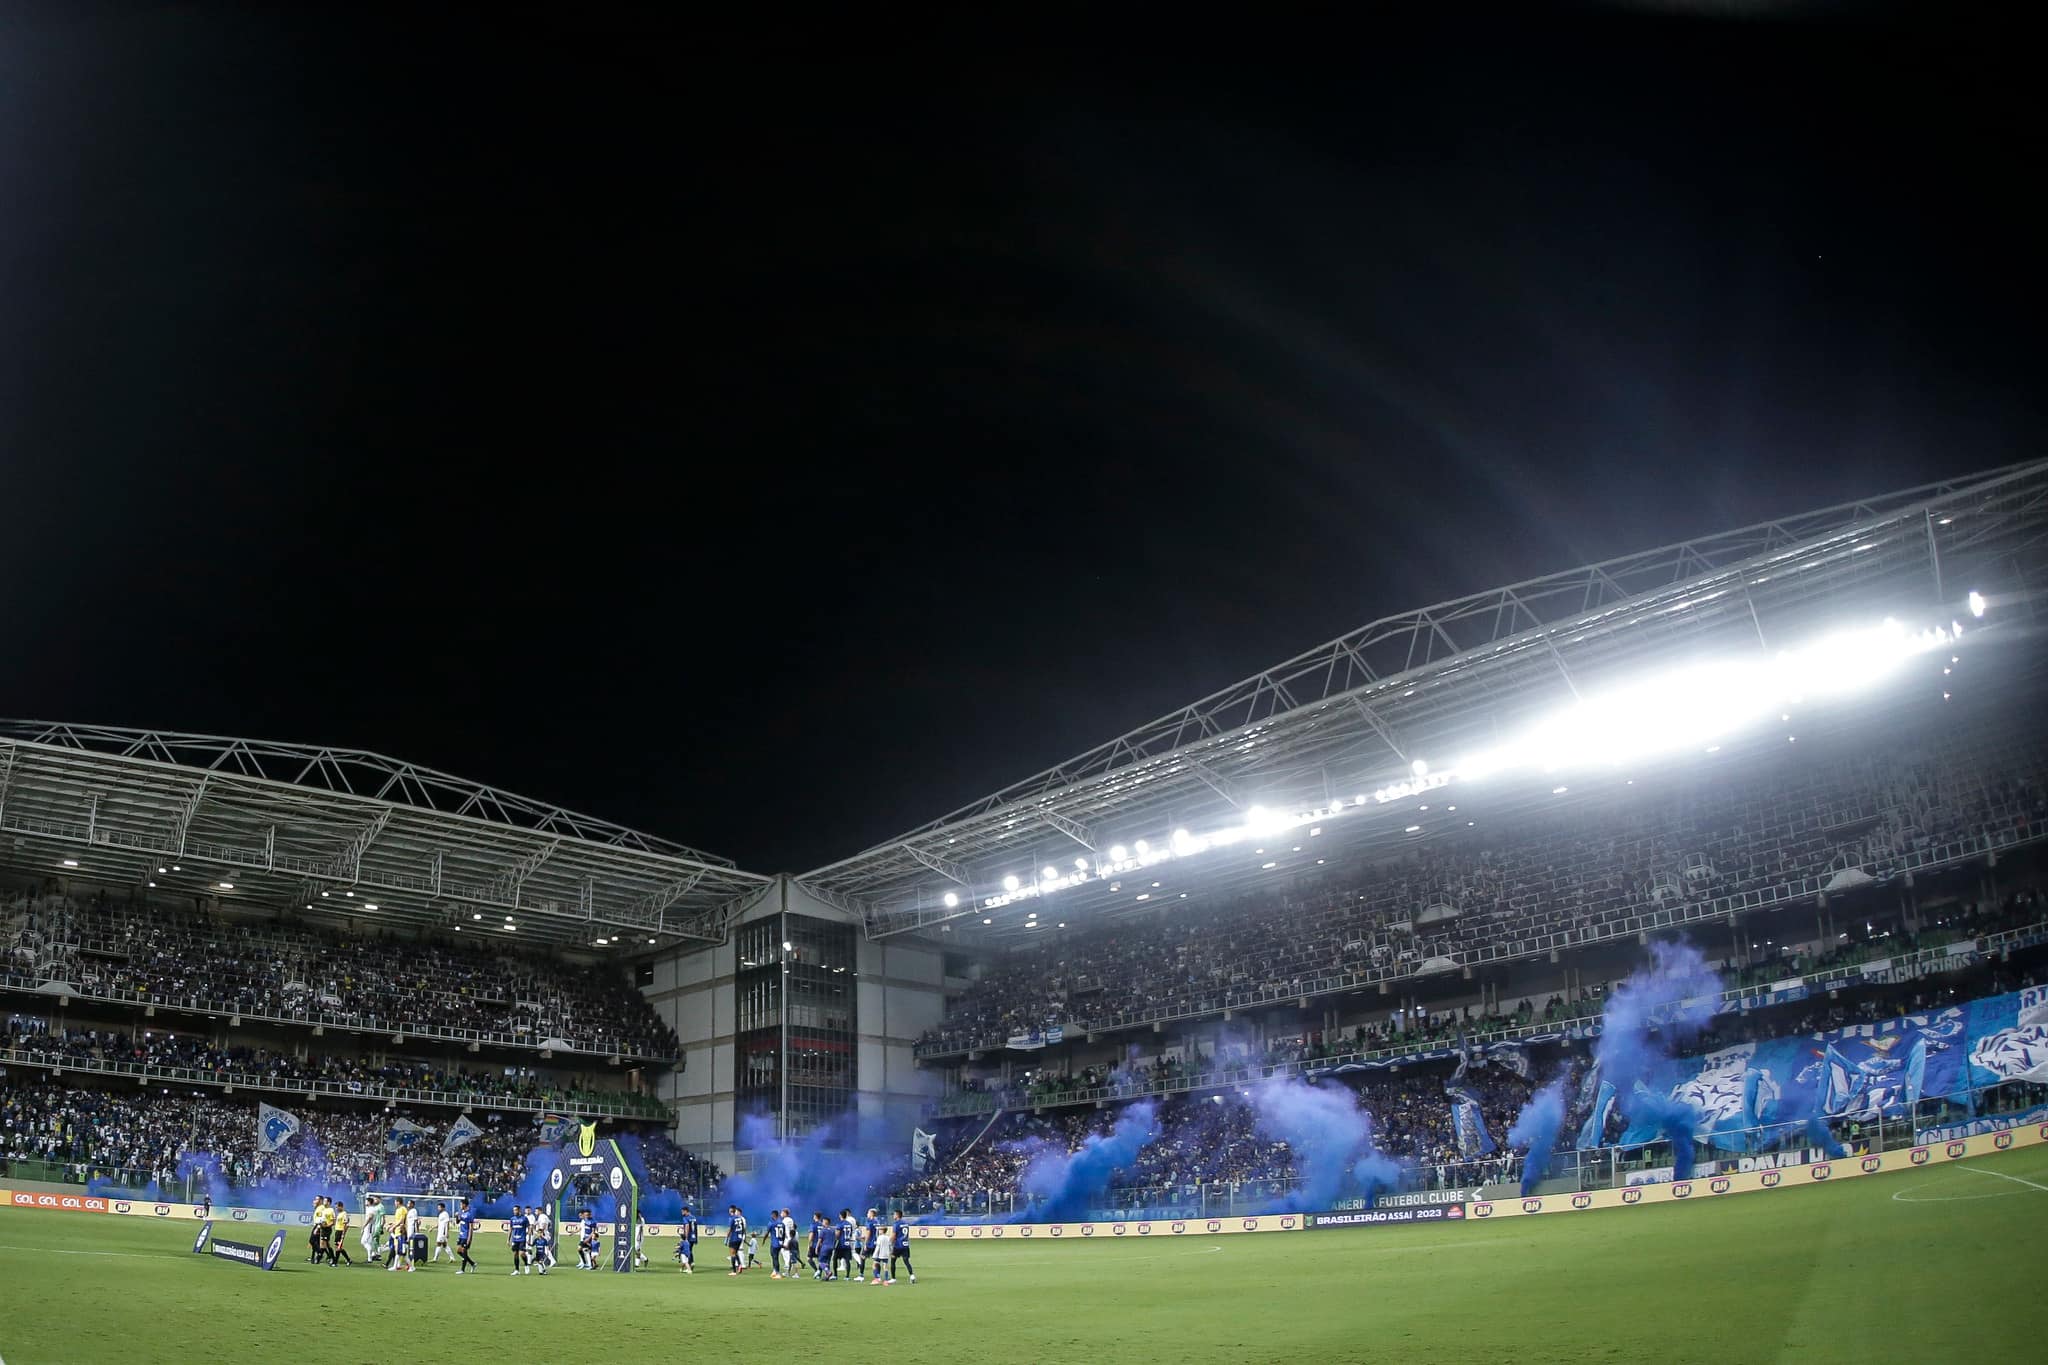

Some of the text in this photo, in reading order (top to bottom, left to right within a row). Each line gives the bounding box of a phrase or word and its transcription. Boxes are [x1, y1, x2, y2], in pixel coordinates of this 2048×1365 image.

[1996, 1135, 2011, 1147] BH
[1949, 1143, 1964, 1156] BH
[1912, 1151, 1928, 1162] BH
[1864, 1159, 1878, 1170] BH
[1814, 1167, 1829, 1178] BH
[1763, 1174, 1778, 1185] BH
[1675, 1185, 1690, 1195] BH
[1713, 1181, 1728, 1192] BH
[1378, 1193, 1427, 1208] FUTEBOL
[1429, 1190, 1465, 1203] CLUBE
[1574, 1196, 1589, 1206] BH
[1624, 1191, 1640, 1201] BH
[15, 1194, 104, 1210] GOL GOL GOL GOL
[117, 1203, 129, 1212] BH
[1525, 1201, 1540, 1211] BH
[156, 1206, 169, 1215] BH
[234, 1211, 247, 1220] BH
[1477, 1205, 1492, 1215] BH
[1316, 1211, 1387, 1225] BRASILEIRÃO
[1388, 1210, 1413, 1221] ASSAÍ
[1416, 1209, 1442, 1218] 2023
[774, 1227, 784, 1238] 10
[902, 1227, 908, 1238] 9
